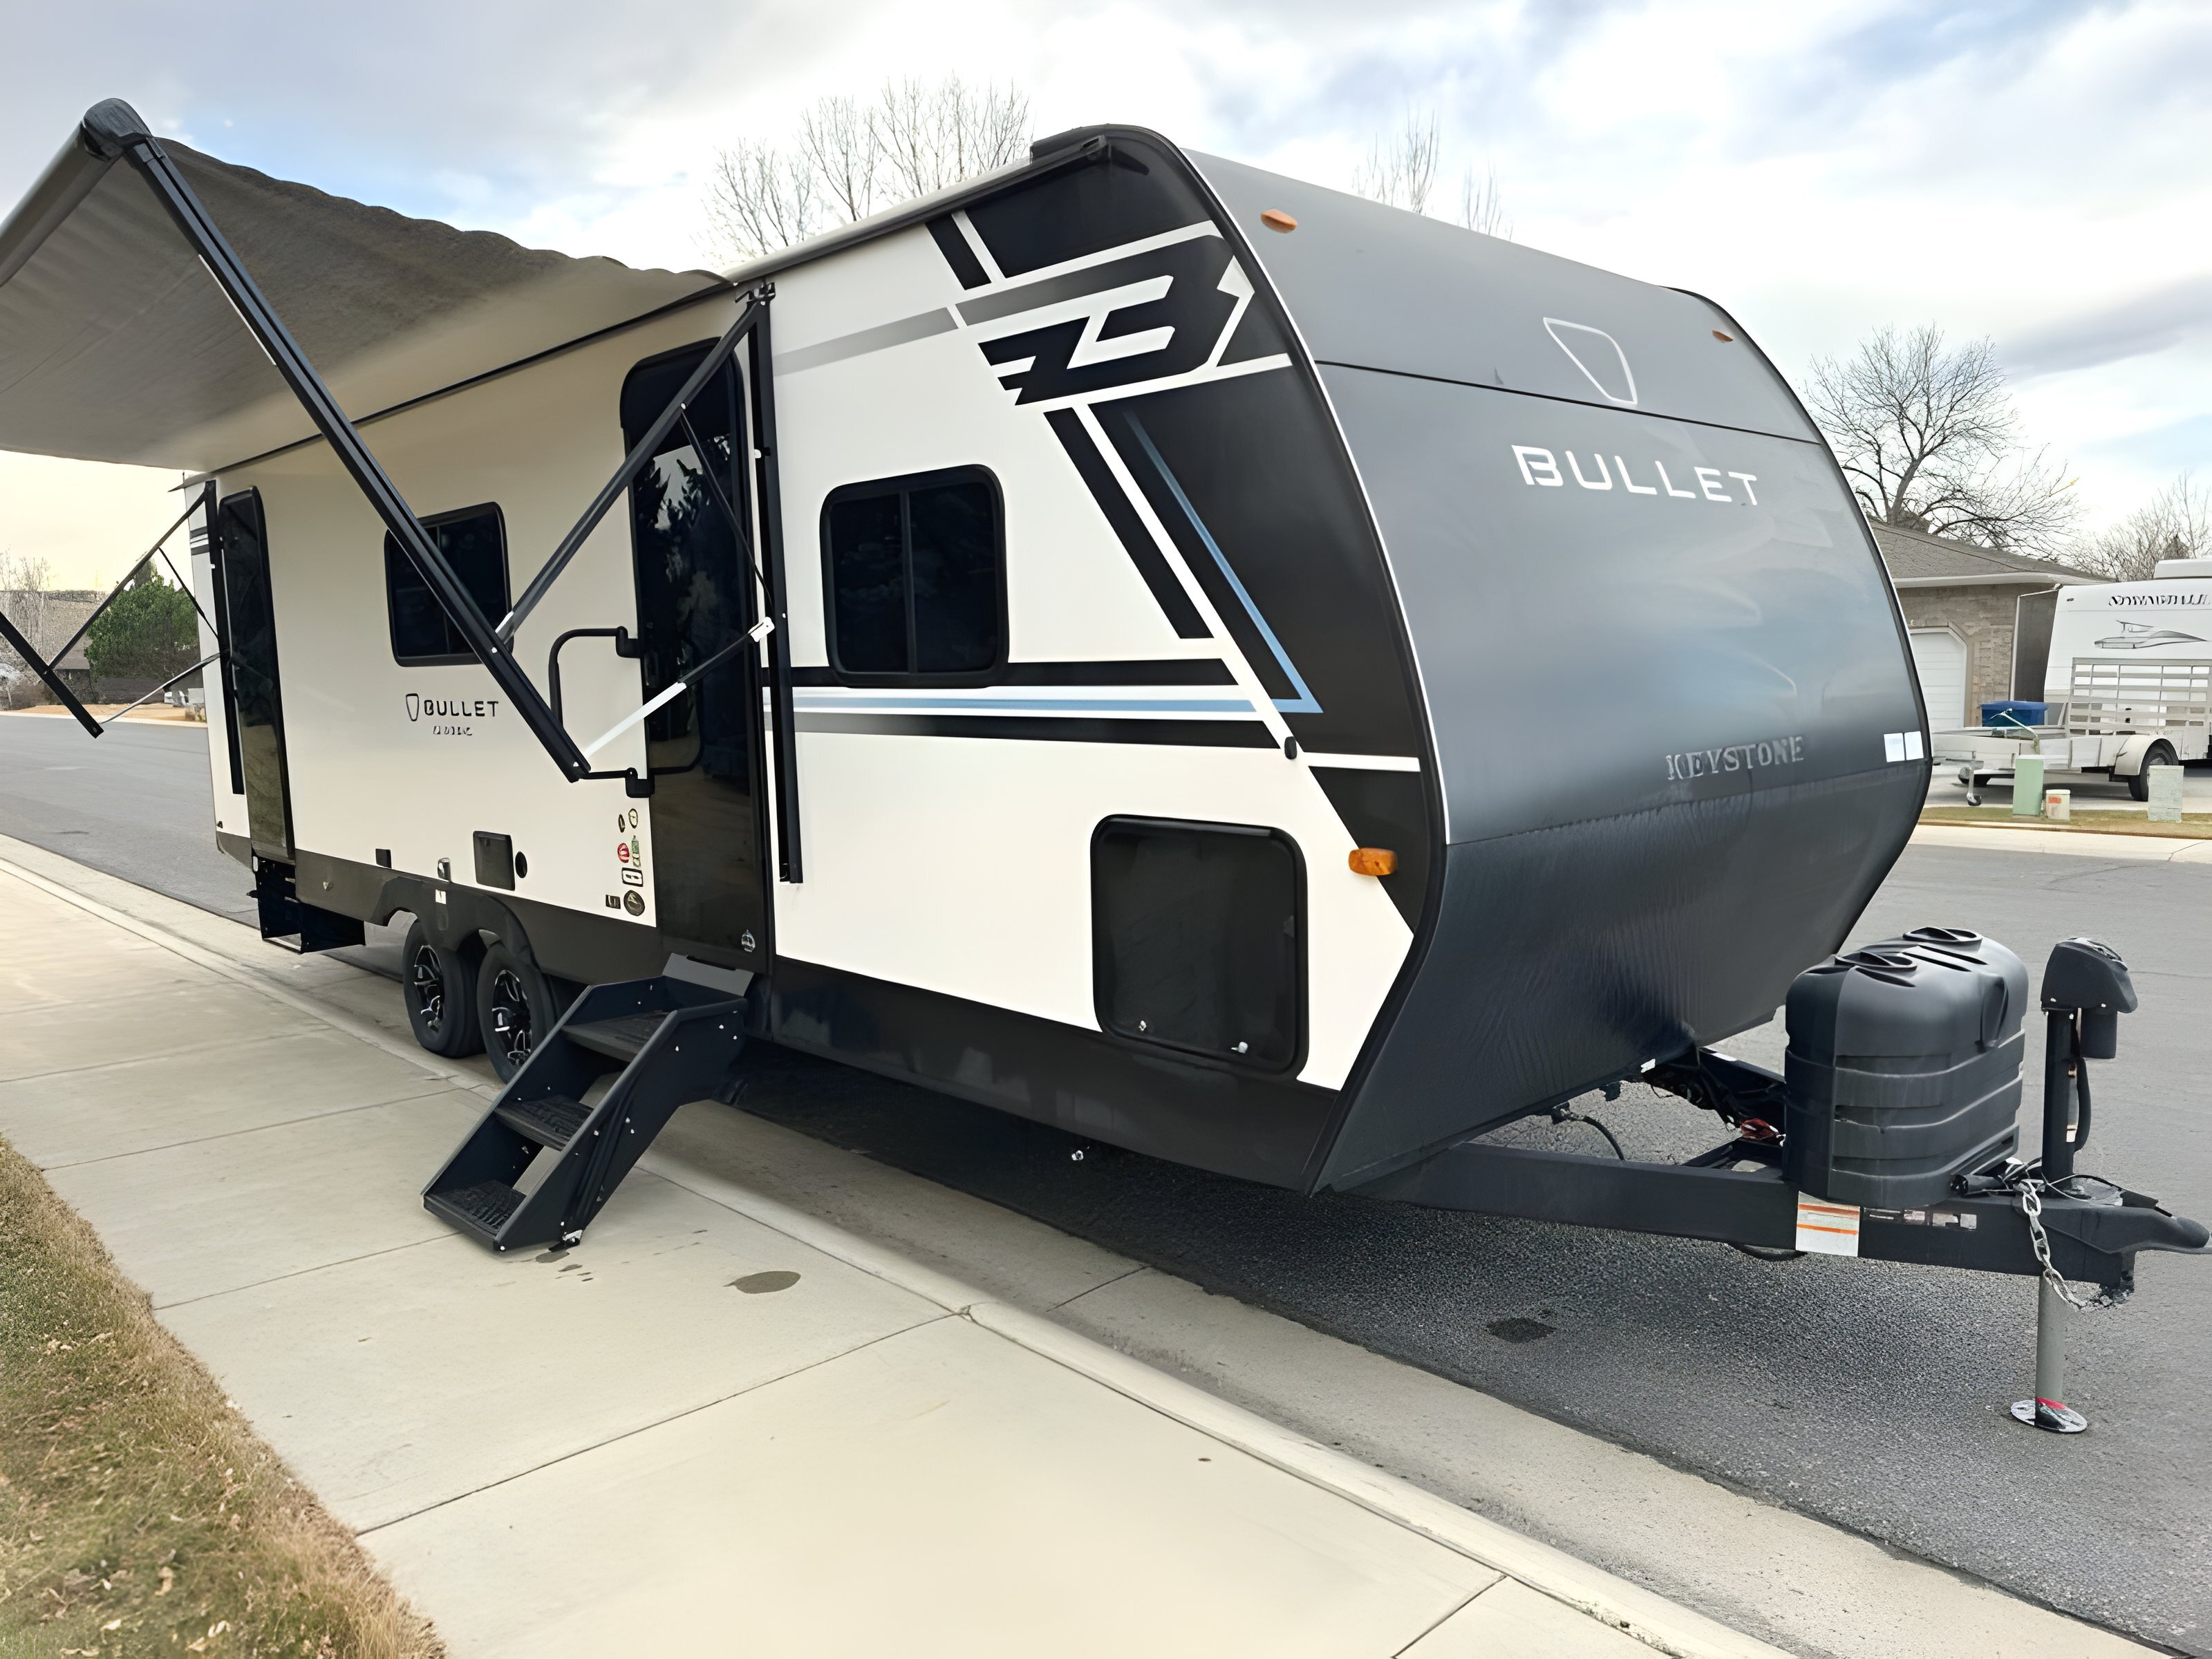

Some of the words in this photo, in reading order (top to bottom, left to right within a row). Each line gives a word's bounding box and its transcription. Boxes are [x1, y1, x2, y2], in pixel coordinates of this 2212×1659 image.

[1511, 444, 1758, 506] BULLET
[424, 700, 499, 718] BULLET
[1665, 735, 1804, 780] KEYSTONE
